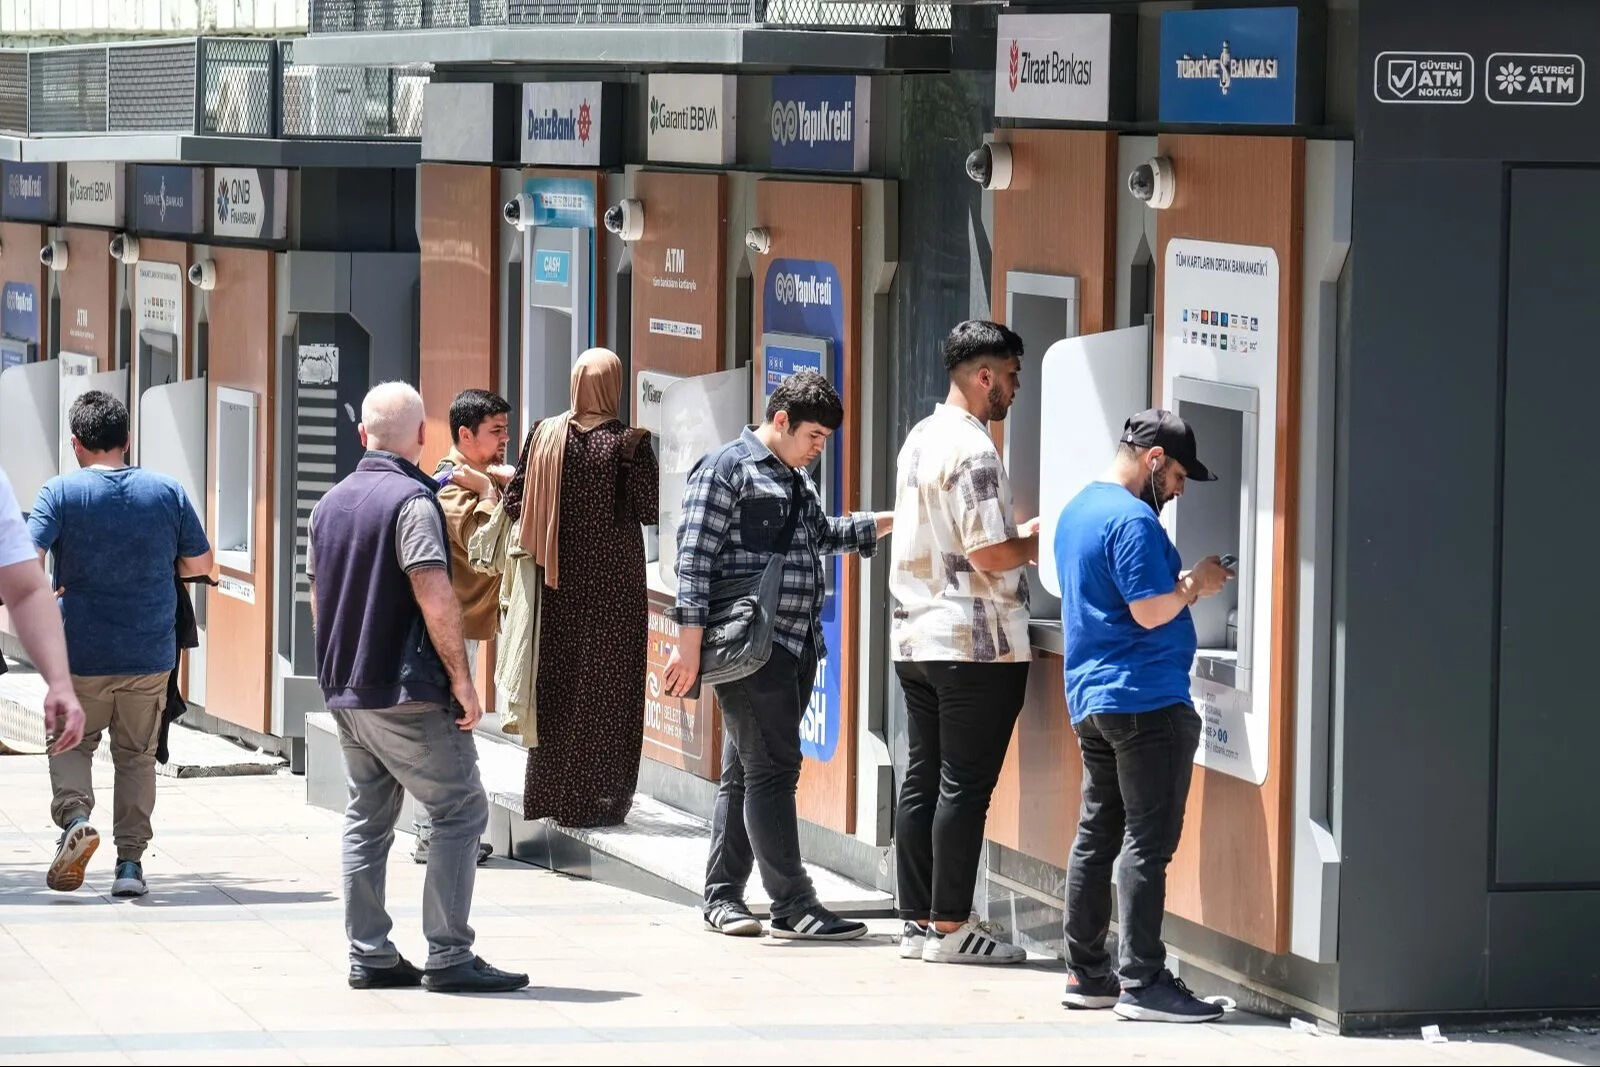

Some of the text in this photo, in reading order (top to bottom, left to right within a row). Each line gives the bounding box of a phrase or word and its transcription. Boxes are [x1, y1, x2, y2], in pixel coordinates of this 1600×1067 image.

[1020, 50, 1092, 86] Ziraat Bankası
[1176, 54, 1220, 79] TÜRKİYE
[1230, 56, 1278, 79] BANKASI
[1419, 60, 1463, 71] GÜVENLİ
[1530, 65, 1575, 75] ÇEVRECİ
[1417, 71, 1463, 87] ATM
[1527, 76, 1574, 94] ATM
[1418, 88, 1462, 97] NOKTASI
[527, 109, 576, 141] DenizBank
[658, 103, 718, 132] Garanti BBVA
[798, 100, 852, 148] YapıKredi
[74, 179, 113, 202] Garanti BBVA
[230, 179, 251, 204] QNB
[543, 256, 561, 272] CASH
[664, 248, 685, 274] ATM
[648, 612, 659, 632] ASH
[645, 698, 661, 730] DCC
